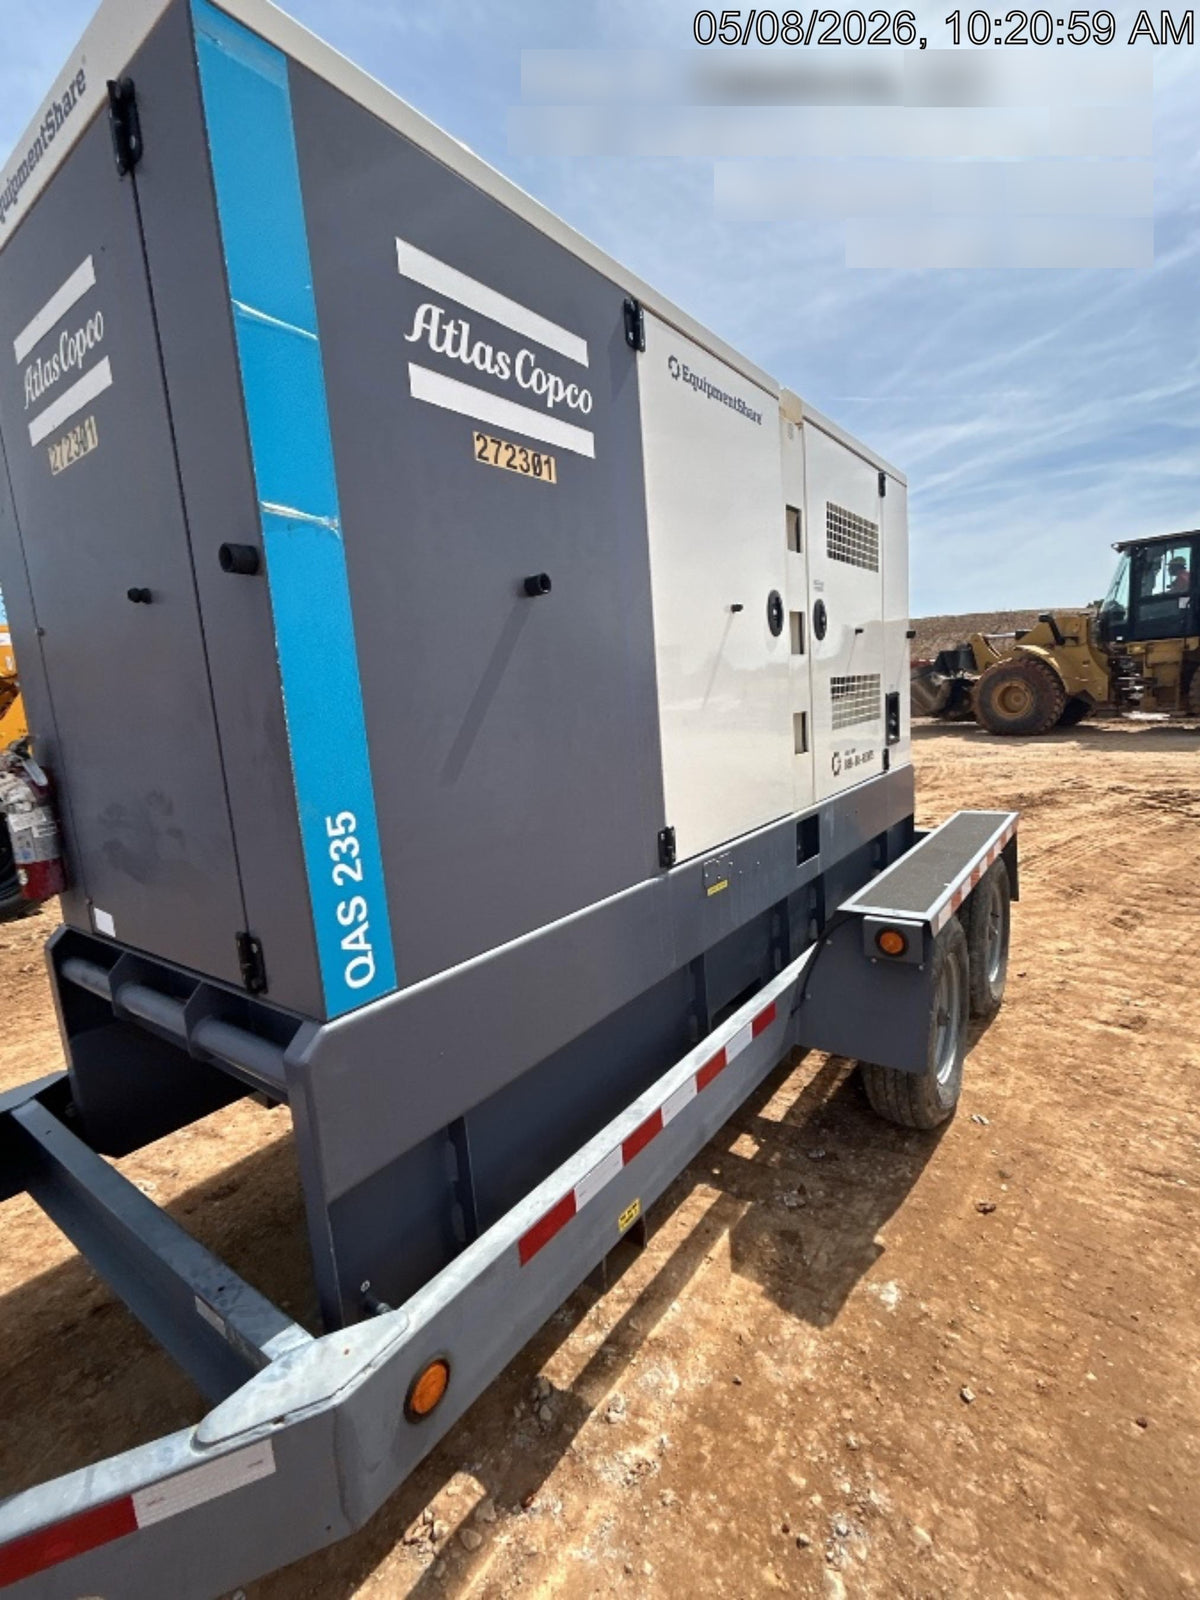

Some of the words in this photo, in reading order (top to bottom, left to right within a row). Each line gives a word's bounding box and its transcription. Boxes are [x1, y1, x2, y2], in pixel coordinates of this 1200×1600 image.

[24, 357, 61, 410] Atlas
[59, 310, 104, 369] Copco
[404, 303, 511, 380] Atlas
[515, 349, 593, 414] Copco
[681, 363, 763, 426] EquipmentShare
[475, 432, 553, 482] 272301
[325, 811, 364, 887] 235
[336, 895, 376, 989] QAS
